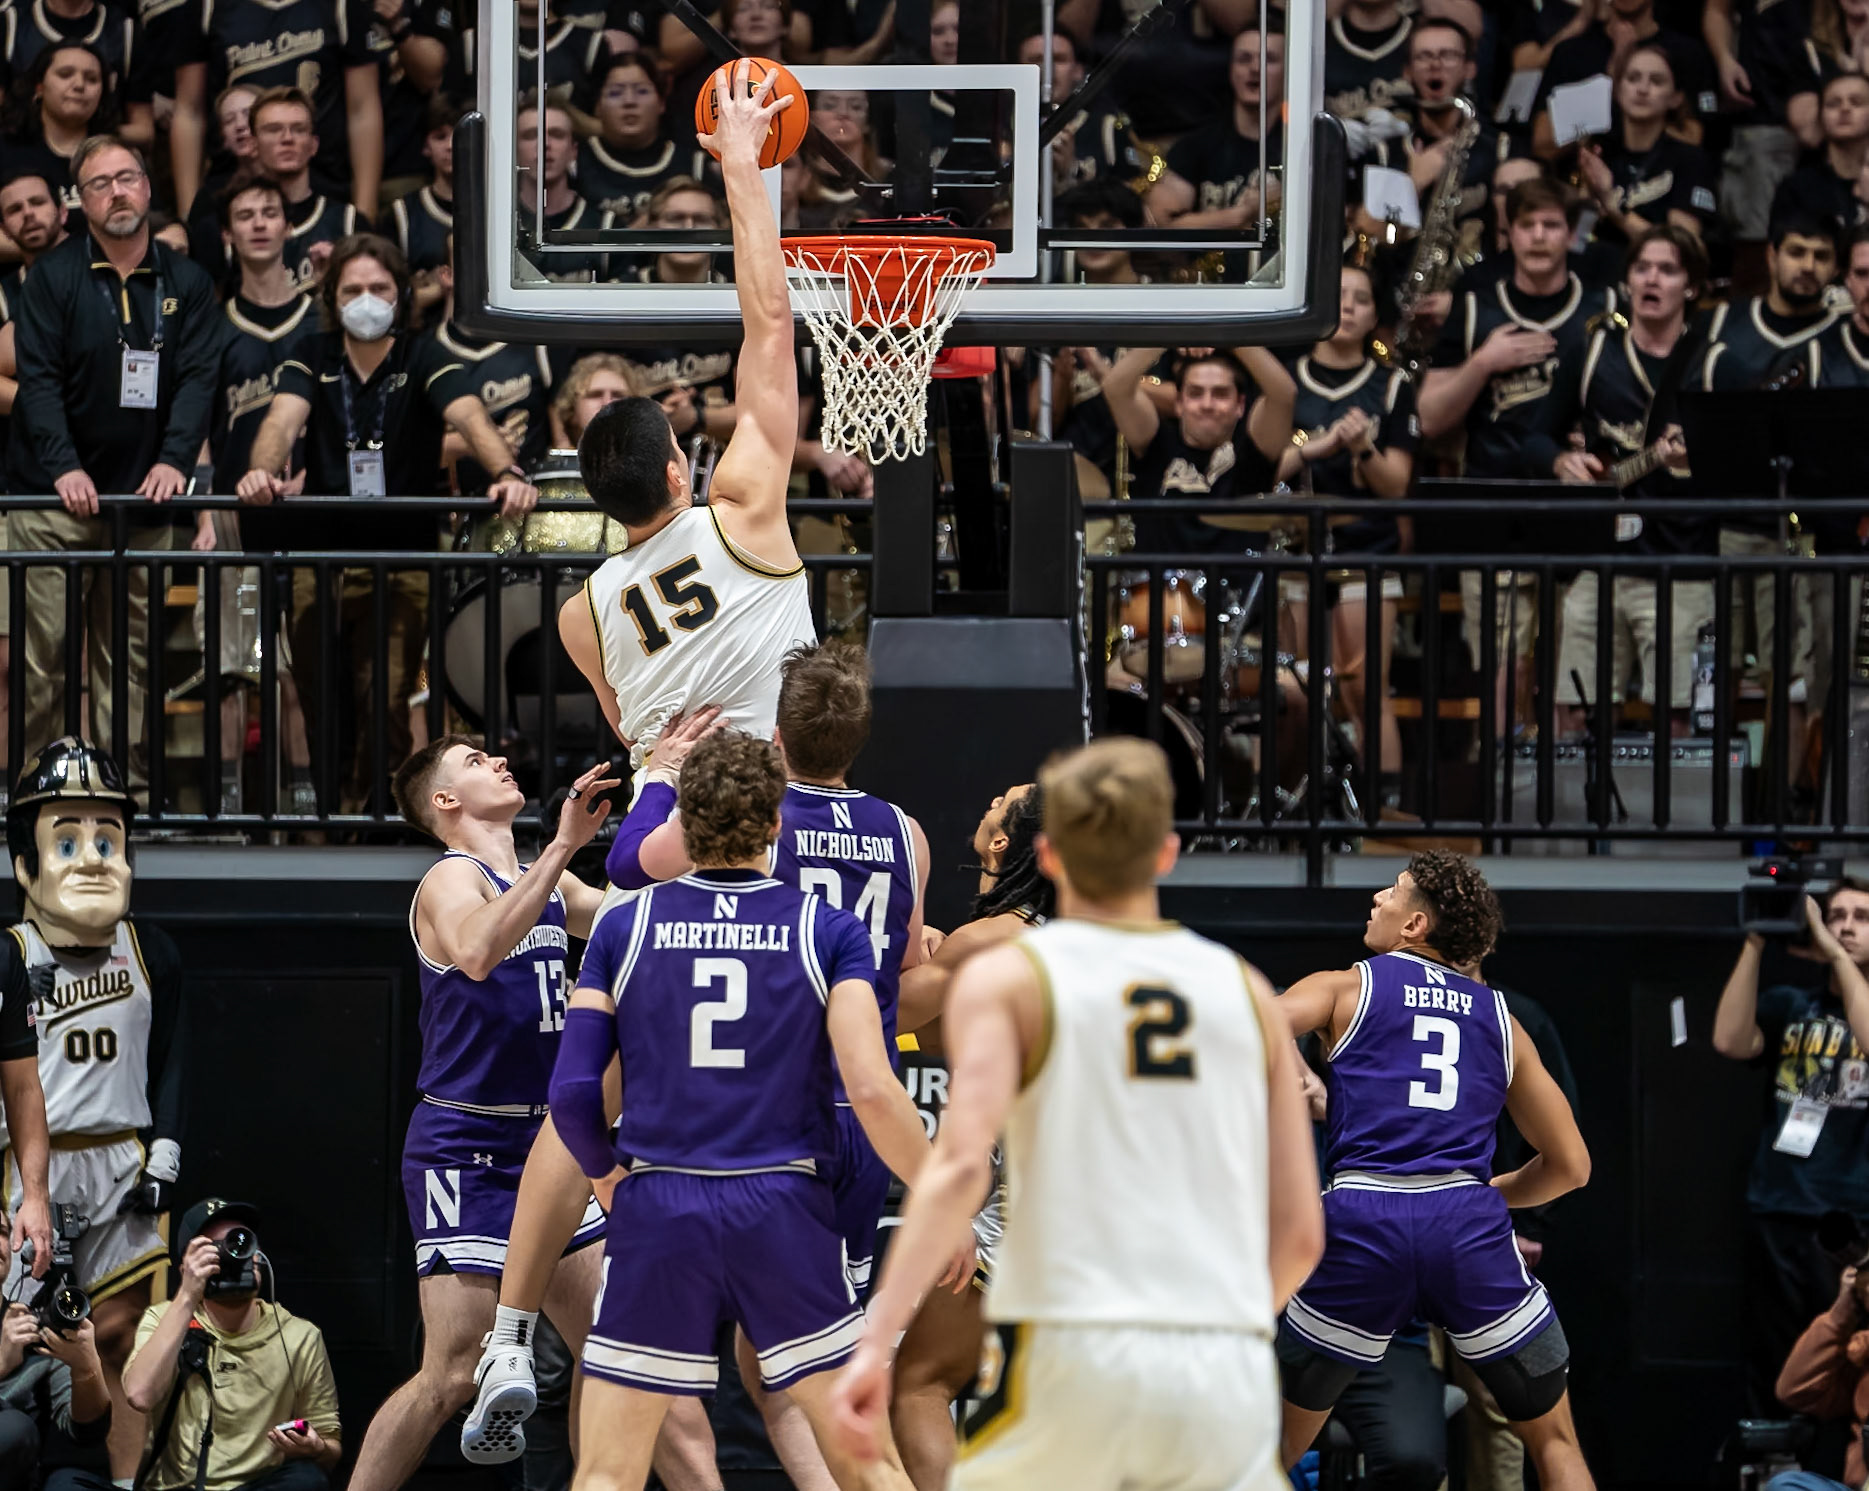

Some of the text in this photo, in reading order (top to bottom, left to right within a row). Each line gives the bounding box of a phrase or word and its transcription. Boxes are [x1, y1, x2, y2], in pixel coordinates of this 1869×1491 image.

[619, 554, 720, 657] 15
[830, 802, 853, 829] N
[794, 829, 896, 863] NICHOLSON
[713, 893, 739, 919] N
[653, 921, 791, 952] MARTINELLI
[1424, 966, 1447, 986] N
[533, 959, 568, 1033] 13
[690, 957, 748, 1069] 2
[1403, 984, 1473, 1016] BERRY
[64, 1027, 118, 1065] 00
[1123, 980, 1197, 1081] 2
[1408, 1014, 1461, 1112] 3
[425, 1169, 461, 1229] N
